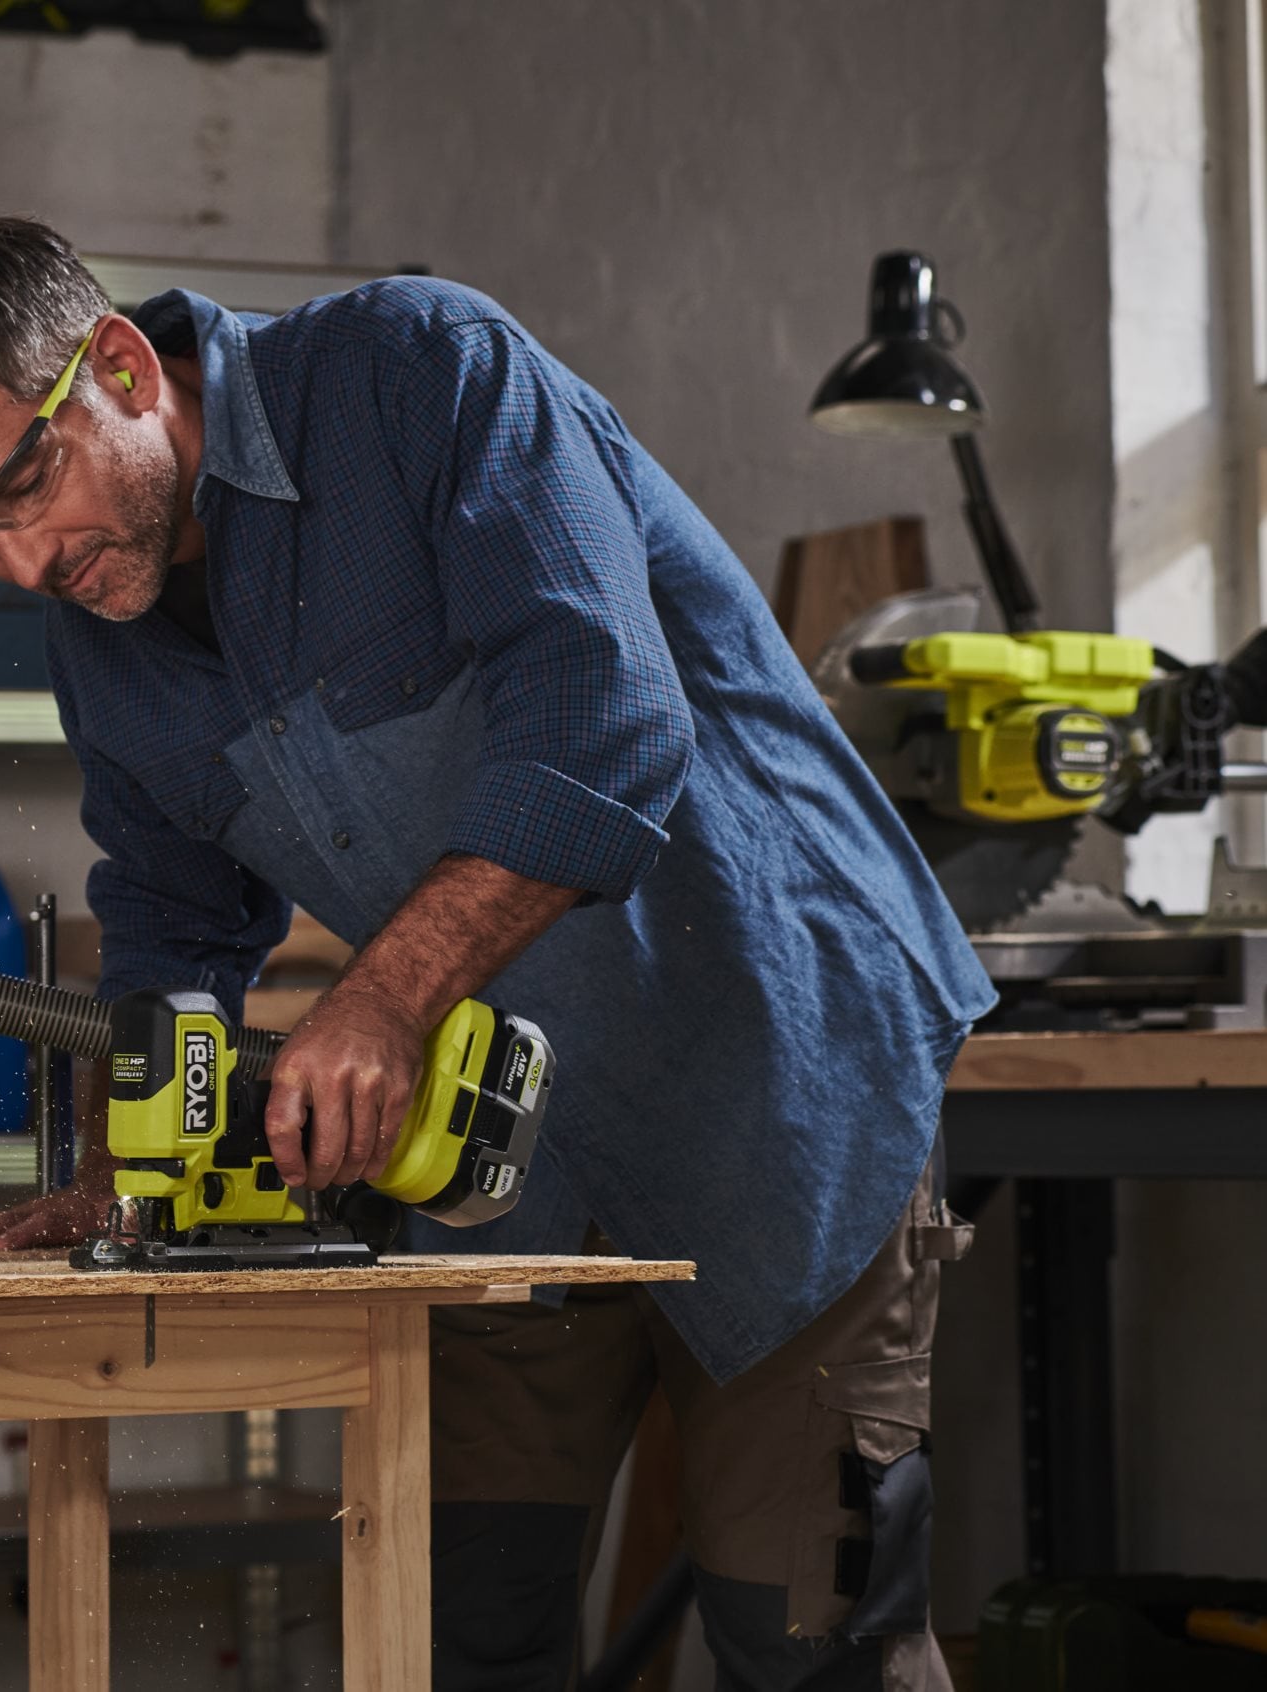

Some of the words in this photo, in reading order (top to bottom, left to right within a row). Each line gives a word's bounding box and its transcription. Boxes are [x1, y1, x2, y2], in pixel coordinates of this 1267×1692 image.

[130, 1057, 145, 1065] HP
[208, 1038, 215, 1060] HP
[516, 1052, 528, 1079] 18V
[185, 1035, 208, 1131] RYOBI
[482, 1164, 496, 1191] RYOBI
